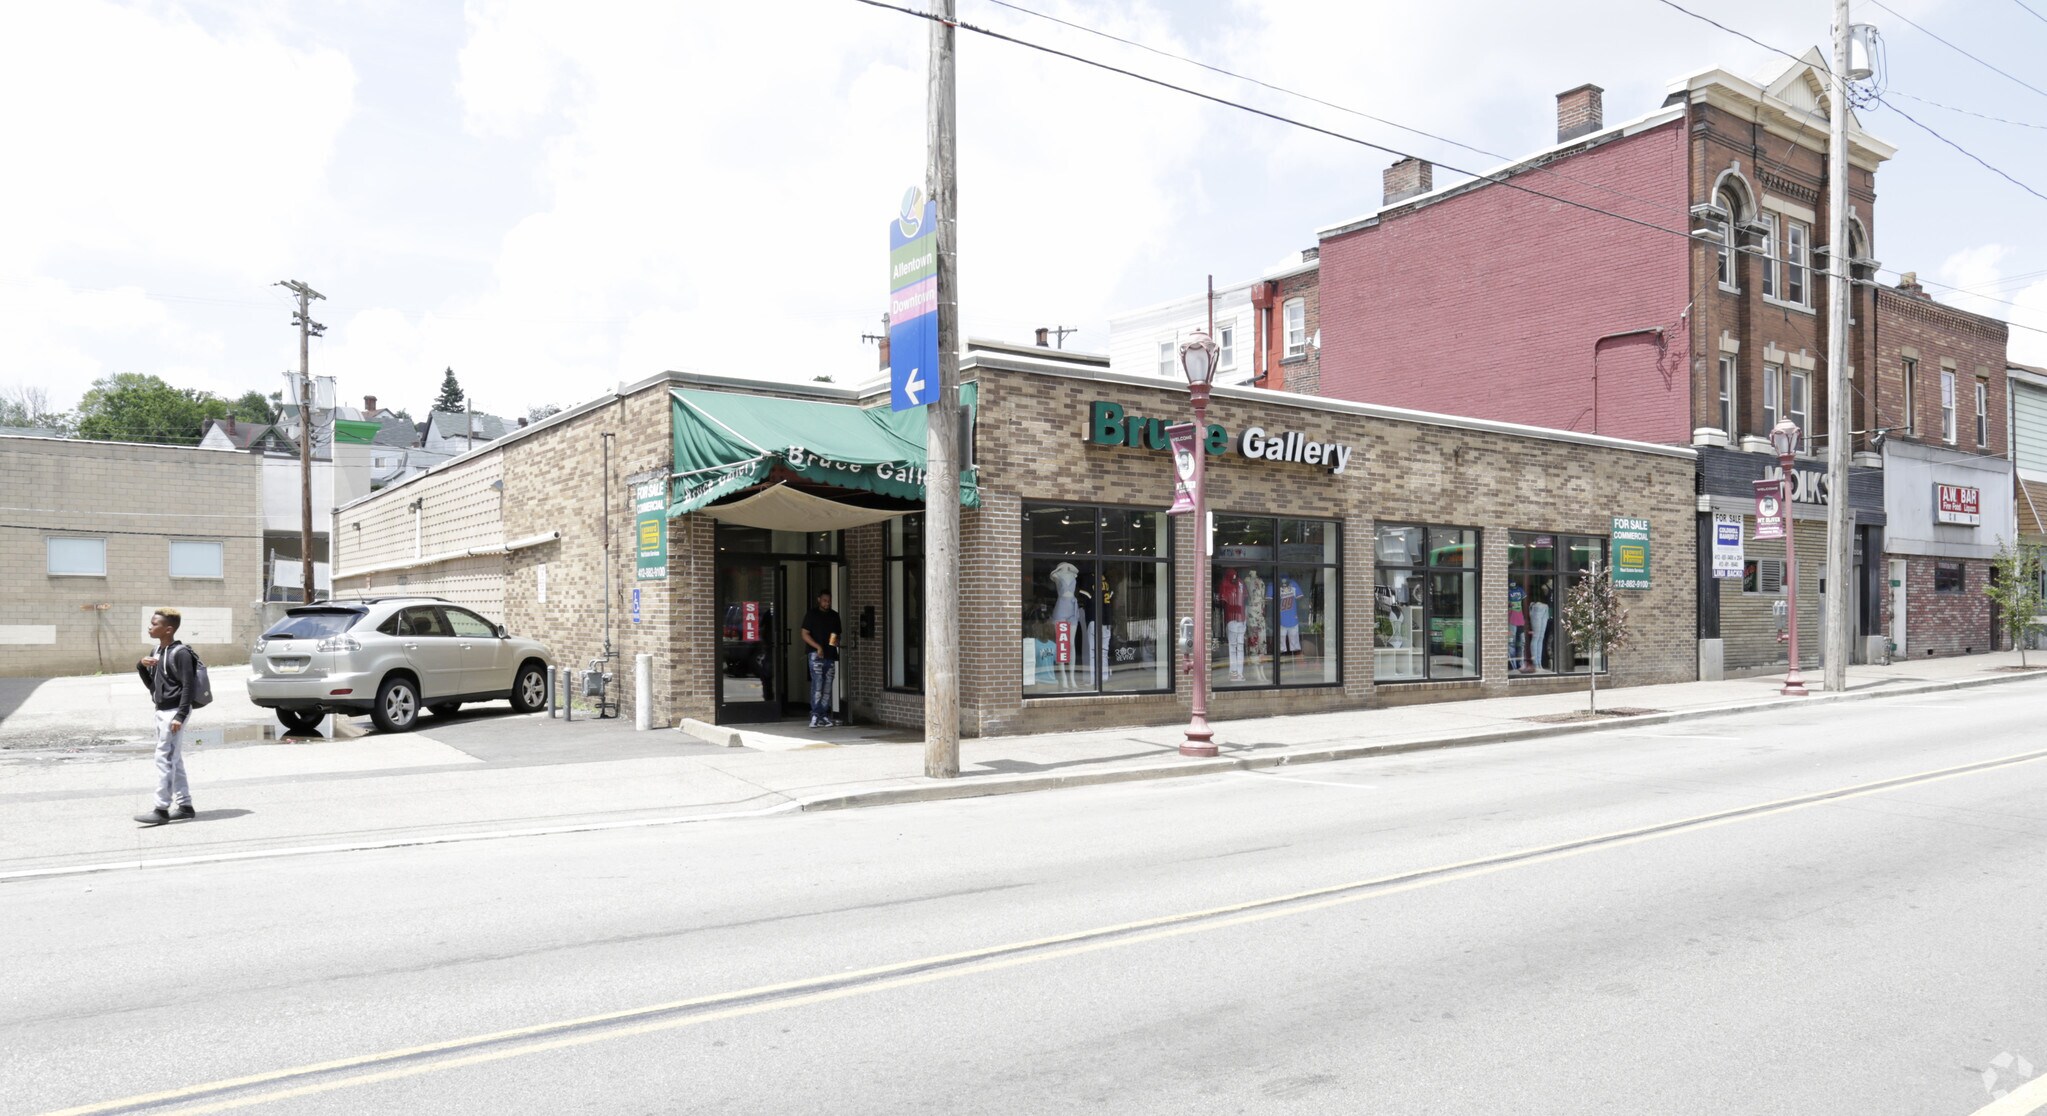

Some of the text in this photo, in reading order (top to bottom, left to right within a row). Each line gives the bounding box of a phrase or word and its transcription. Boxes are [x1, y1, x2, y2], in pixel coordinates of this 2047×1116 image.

[893, 251, 933, 280] Allentown
[893, 287, 935, 315] Downtown
[1090, 400, 1352, 475] Brue Gallery
[788, 444, 862, 473] Bruce
[637, 482, 664, 500] FOR SALE
[1961, 489, 1977, 505] BAR
[637, 499, 665, 514] COMMERCIAL
[1614, 519, 1648, 530] FOR SALE
[1715, 513, 1741, 524] FOR SALE
[1613, 531, 1648, 541] COMMERCIAL
[746, 603, 756, 640] SALE
[1059, 623, 1068, 661] SALE
